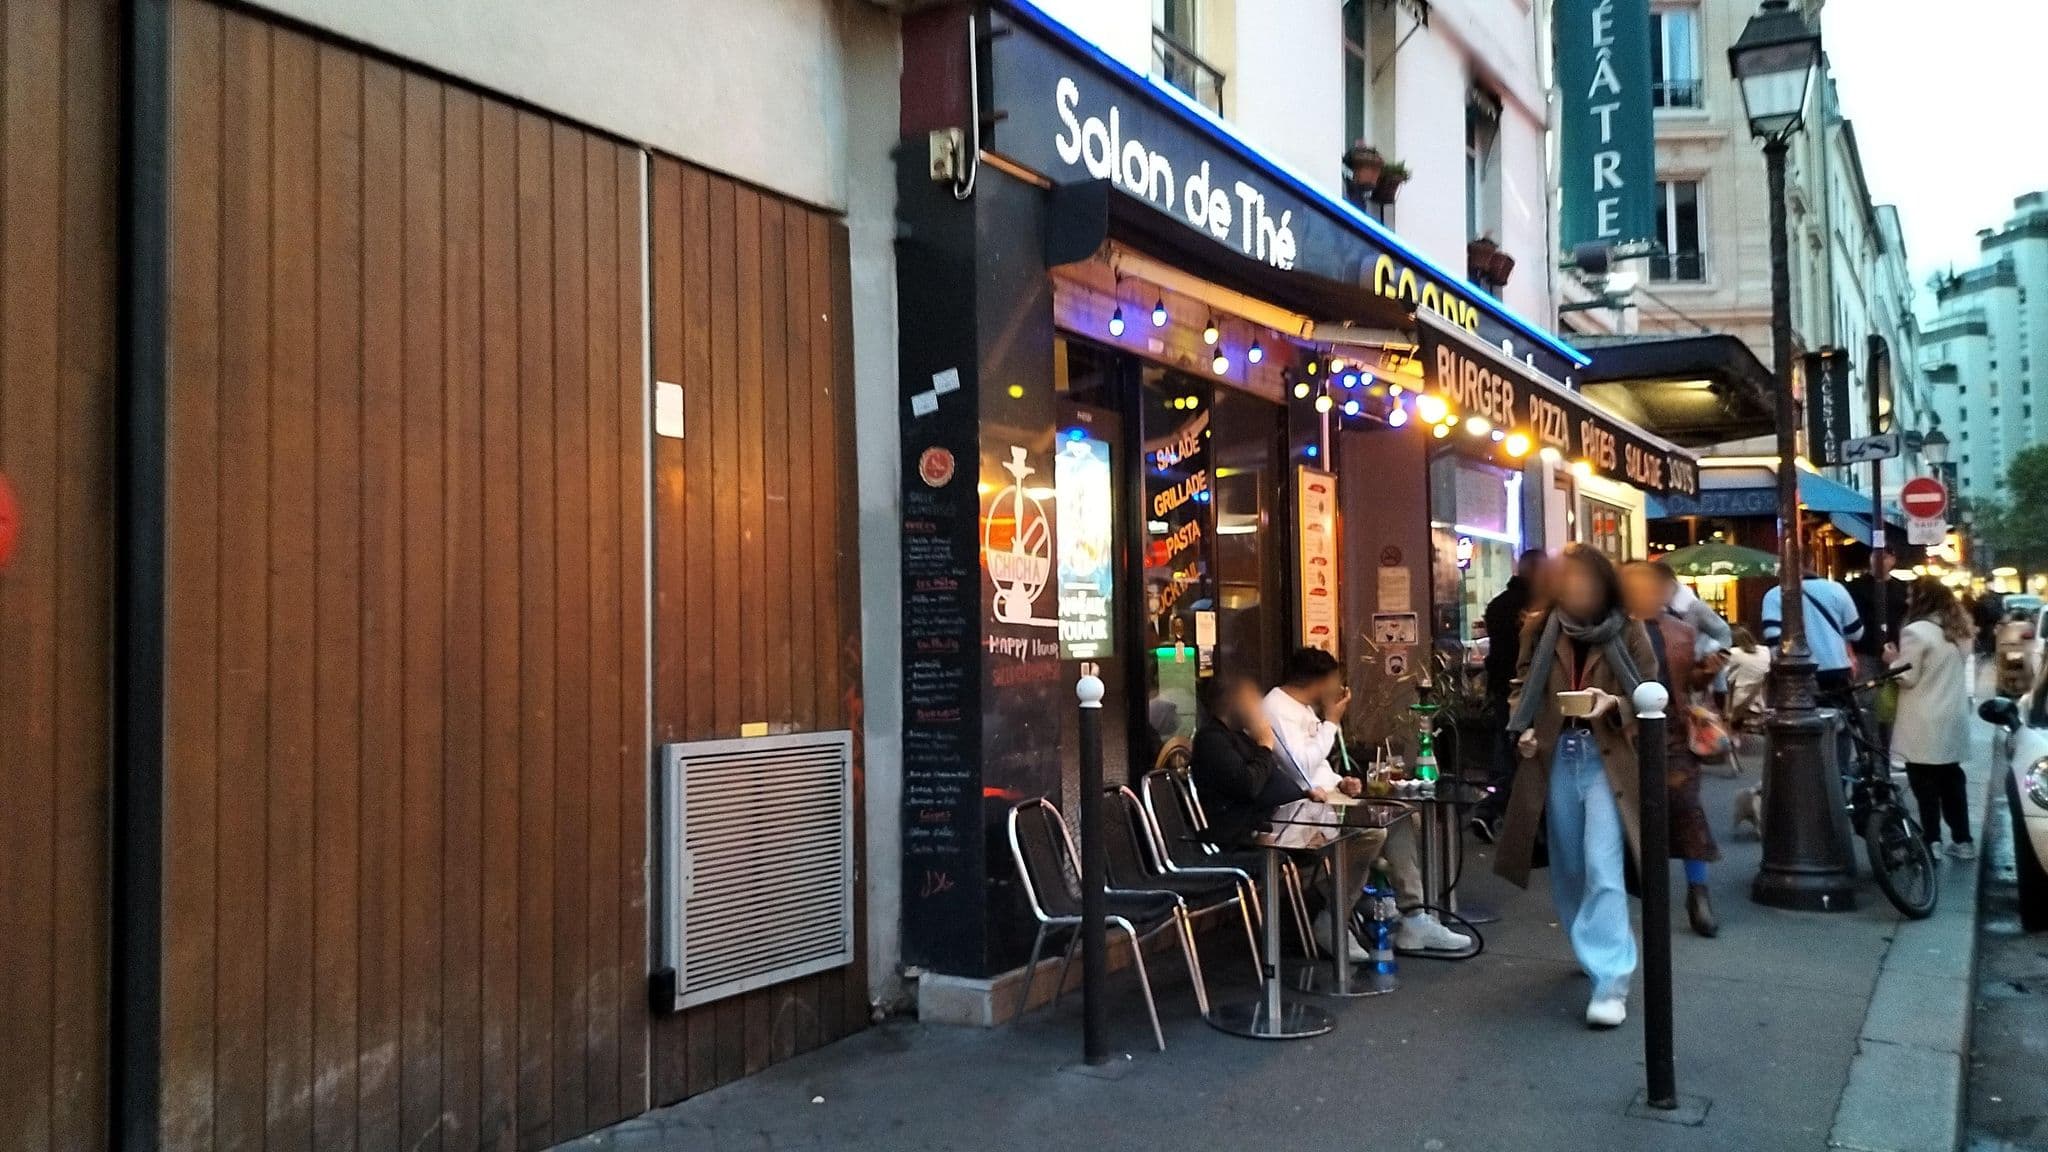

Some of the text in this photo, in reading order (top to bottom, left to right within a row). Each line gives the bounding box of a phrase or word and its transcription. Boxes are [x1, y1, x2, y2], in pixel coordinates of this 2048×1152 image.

[1055, 76, 1297, 271] Salon de Thé
[1436, 343, 1516, 428] BURGER
[1529, 393, 1570, 451] PIZZA
[1624, 442, 1663, 491] SALADE
[1821, 360, 1836, 463] BACKSTAGE
[1156, 432, 1201, 472] SALADE
[1153, 469, 1208, 518] GRILLADE
[1165, 519, 1201, 560] PASTA
[994, 555, 1041, 581] CHICHA
[989, 634, 1029, 663] HAPPY
